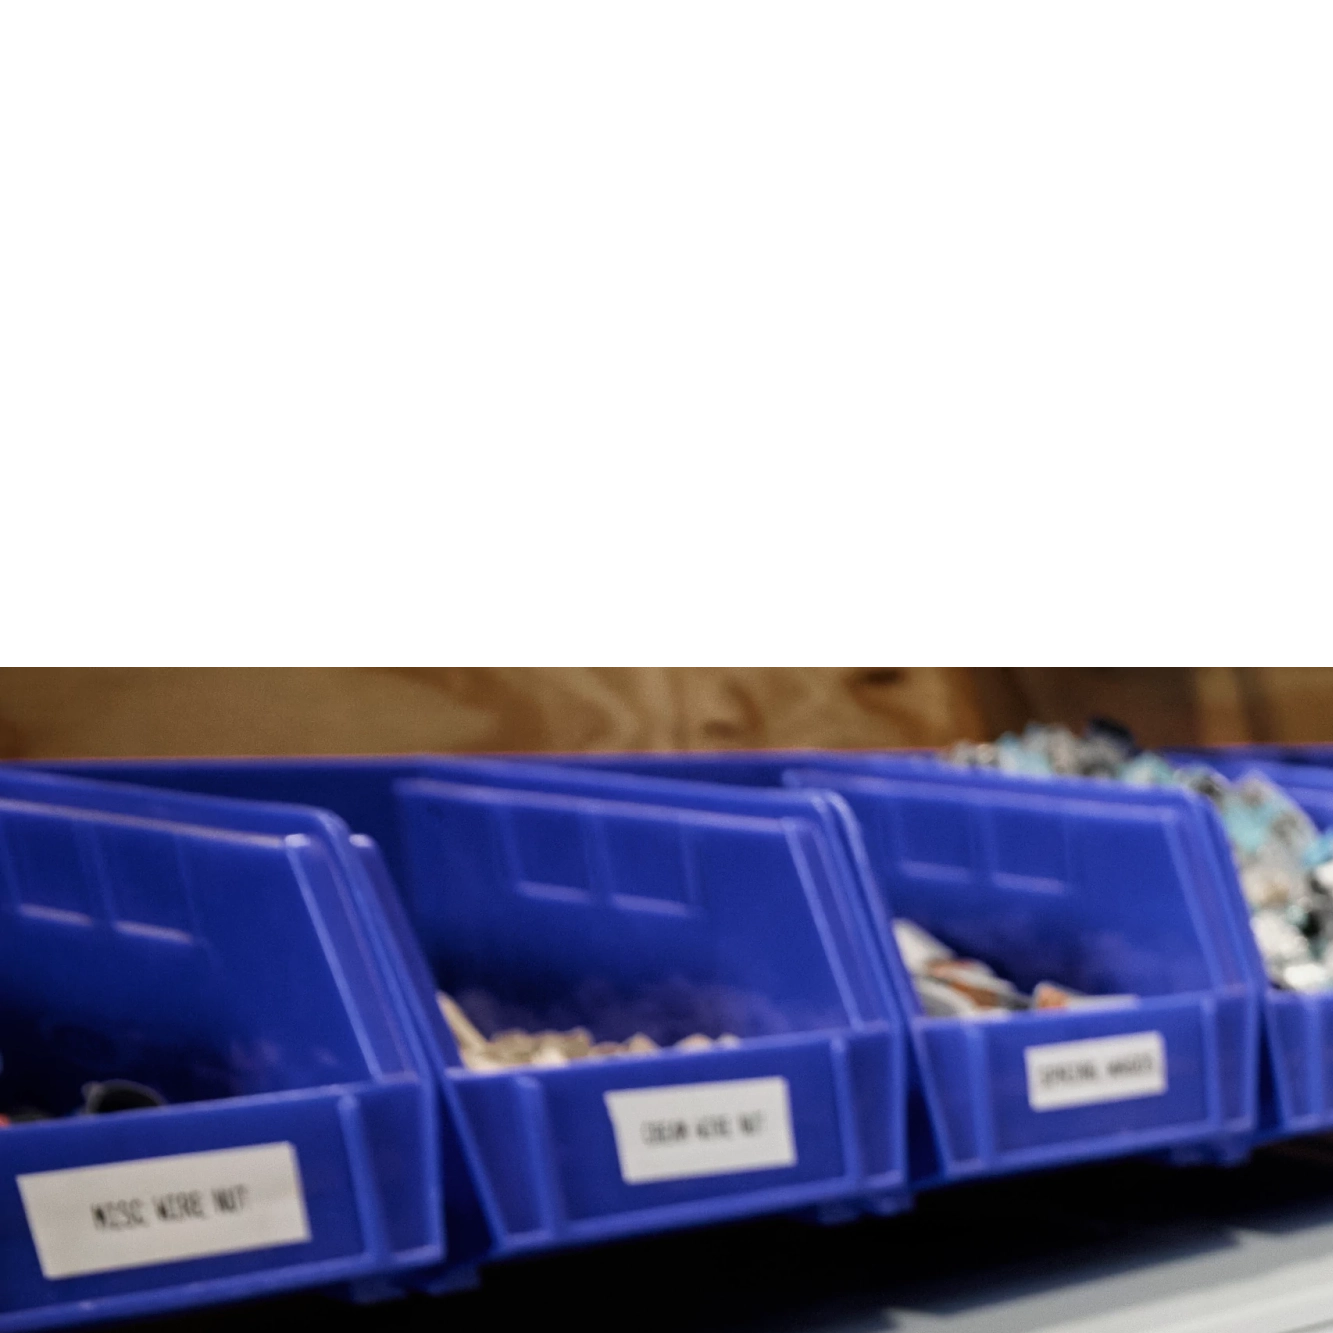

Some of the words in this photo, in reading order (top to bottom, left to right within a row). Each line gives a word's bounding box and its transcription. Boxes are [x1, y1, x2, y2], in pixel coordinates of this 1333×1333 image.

[91, 1197, 147, 1231] MISC
[154, 1189, 205, 1223] WIRE
[209, 1183, 250, 1217] NUT
